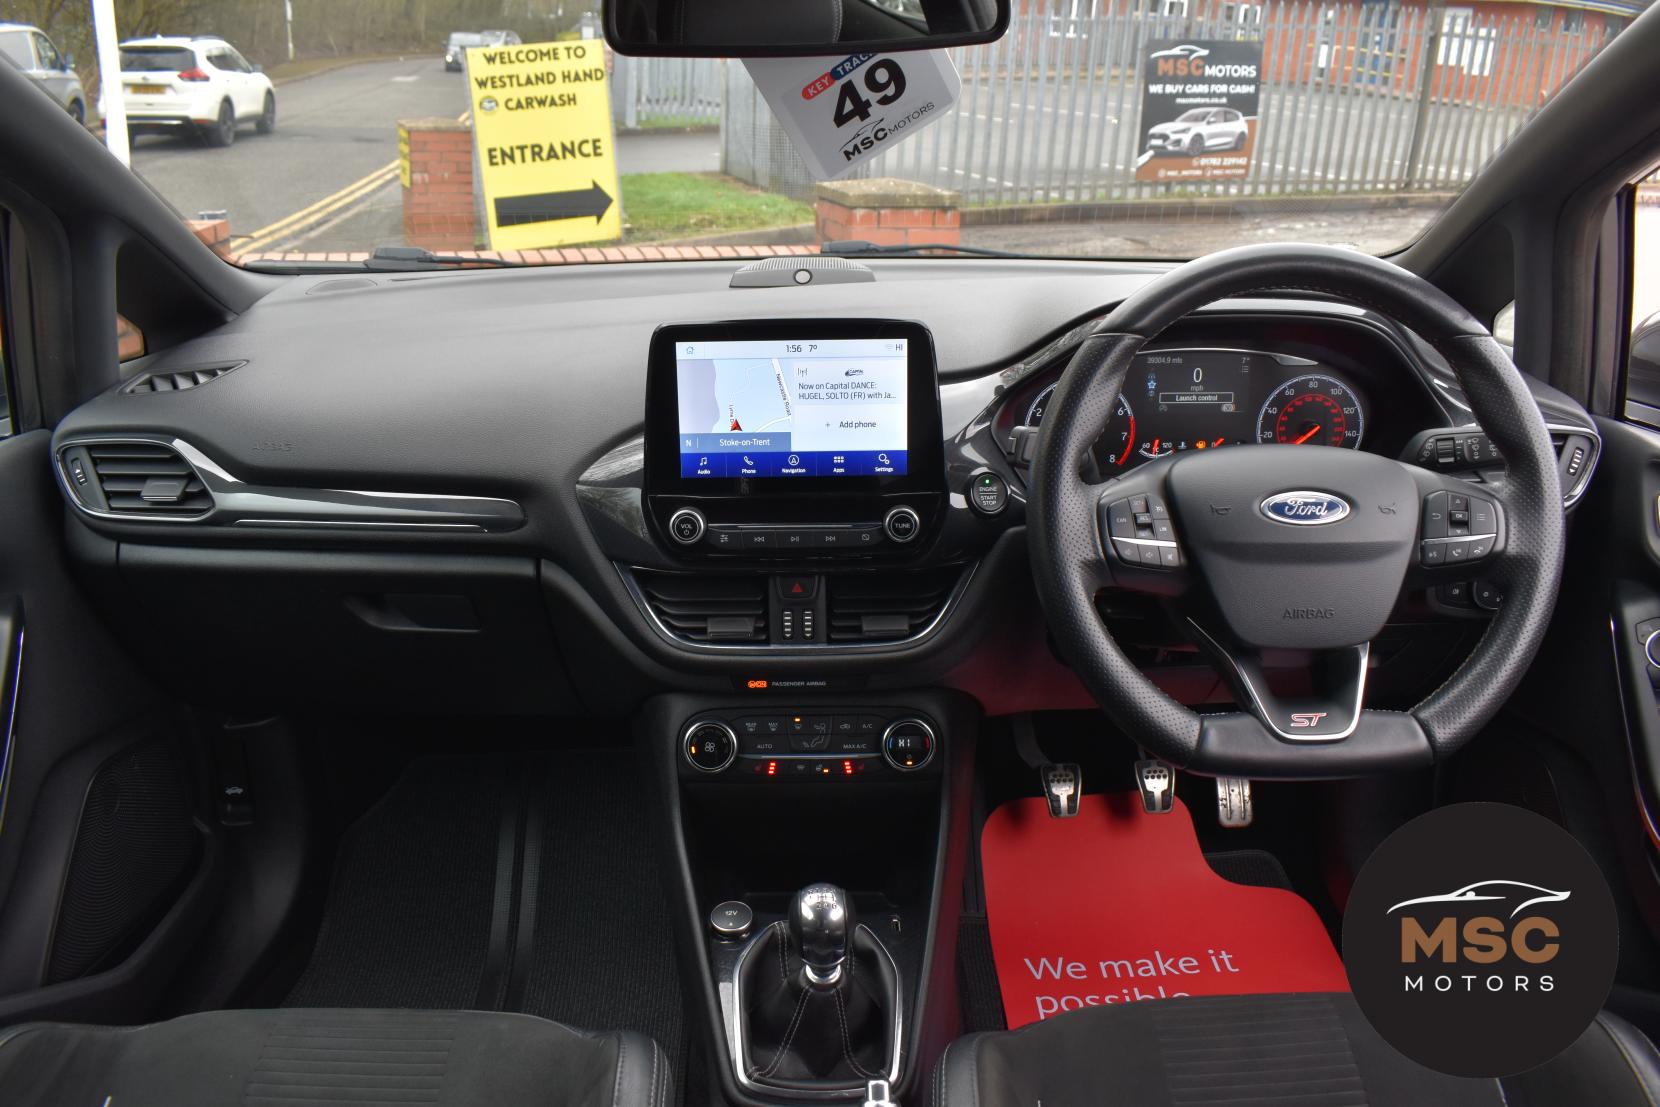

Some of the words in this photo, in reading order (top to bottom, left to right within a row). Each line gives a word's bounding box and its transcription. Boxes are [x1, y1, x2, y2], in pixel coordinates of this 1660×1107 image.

[483, 47, 560, 65] WELCOME
[564, 46, 586, 59] TO
[1157, 58, 1204, 77] MSC
[1204, 65, 1257, 77] MOTORS
[475, 71, 556, 89] WESTLAND
[562, 68, 605, 83] HAND
[808, 75, 832, 96] KEY
[836, 53, 873, 76] TRAC
[833, 58, 907, 128] 49
[1148, 84, 1164, 94] WE
[1165, 84, 1184, 94] BUY
[1185, 84, 1209, 94] CARS
[1210, 84, 1228, 94] FOR
[504, 93, 577, 111] CARWASH
[843, 127, 888, 162] MSC
[888, 102, 936, 135] MOTORS
[487, 138, 603, 166] ENTRANCE
[786, 344, 802, 353] 1:56
[895, 343, 903, 351] HI
[1193, 367, 1203, 383] 0
[825, 382, 849, 391] Capital
[851, 382, 877, 390] DANCE:
[798, 393, 824, 401] HUGEL,
[850, 391, 866, 400] (FR)
[867, 391, 883, 399] with
[1036, 408, 1042, 417] 2
[1117, 407, 1124, 416] 6
[839, 420, 853, 428] Add
[854, 420, 877, 429] phone
[685, 439, 692, 447] N
[719, 438, 771, 447] Stoke-on-Trent
[1121, 432, 1128, 441] 7
[1109, 454, 1116, 463] 8
[1284, 497, 1328, 516] Ford
[1282, 607, 1335, 620] AIRBAG
[1290, 712, 1327, 727] ST
[1024, 956, 1088, 980] We
[1099, 950, 1201, 979] make
[1207, 949, 1240, 973] it
